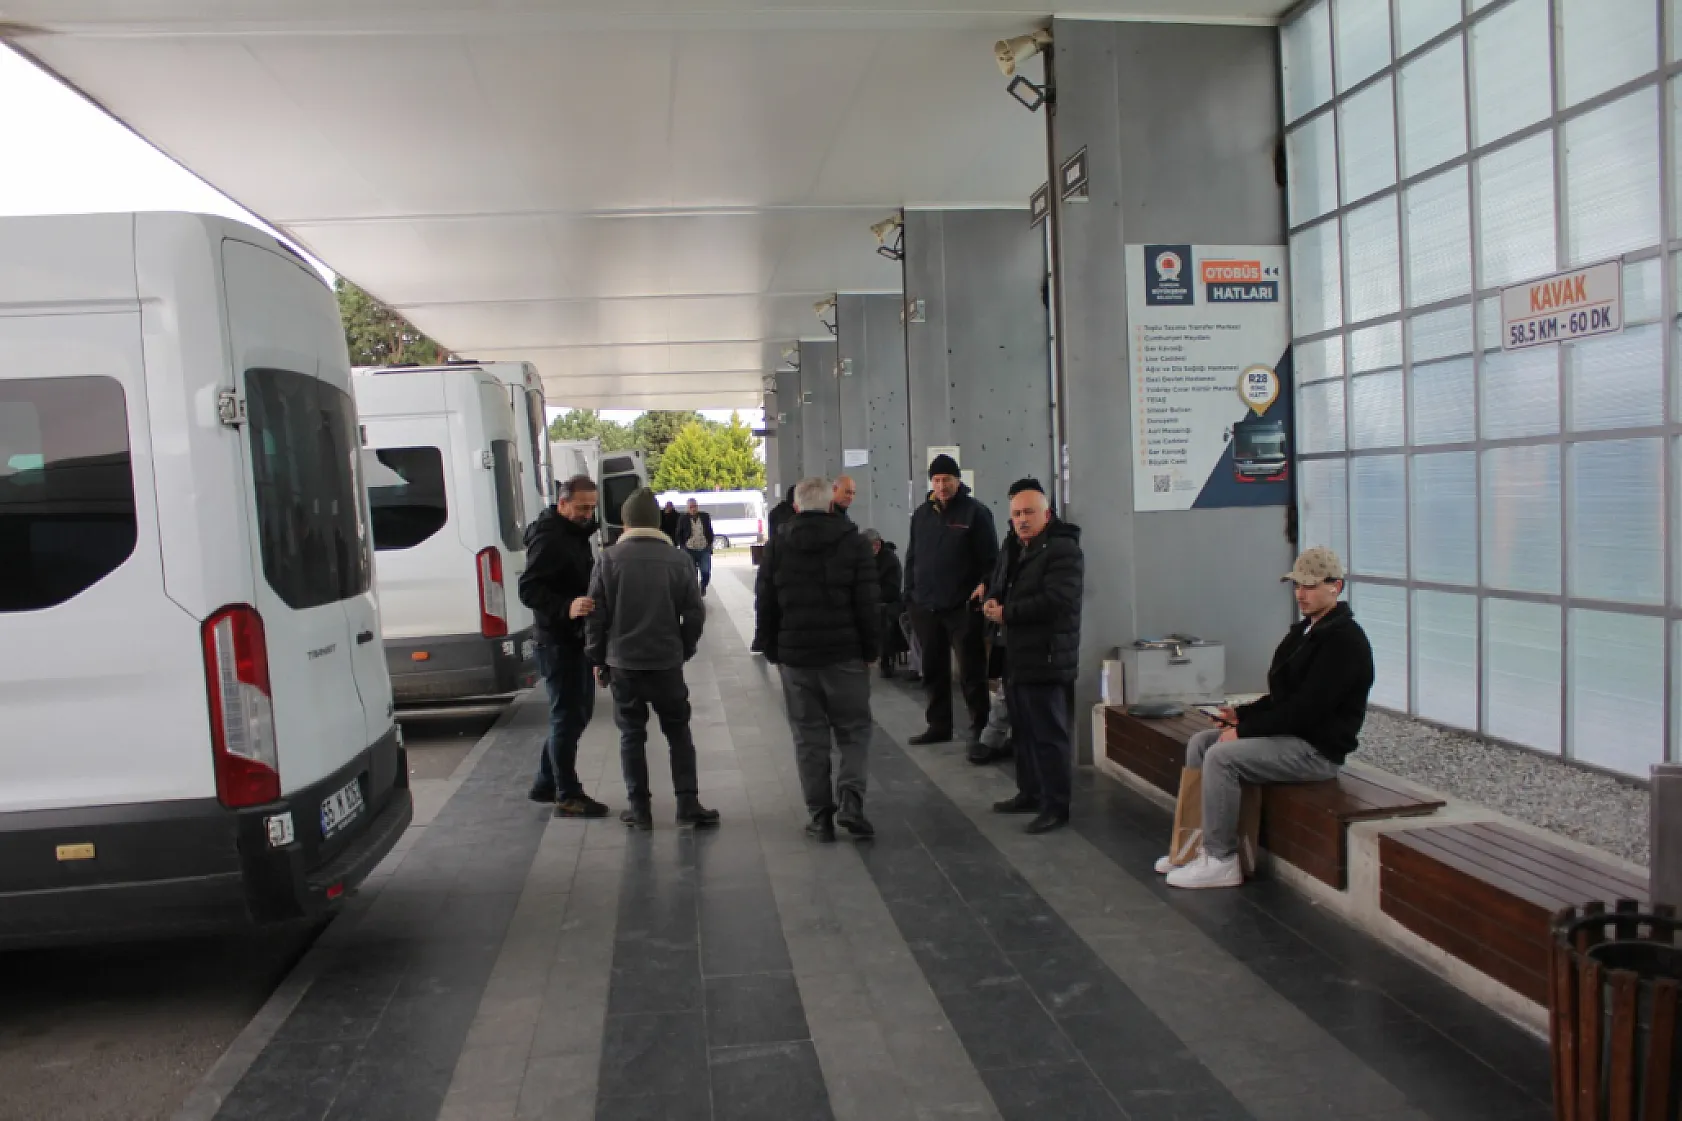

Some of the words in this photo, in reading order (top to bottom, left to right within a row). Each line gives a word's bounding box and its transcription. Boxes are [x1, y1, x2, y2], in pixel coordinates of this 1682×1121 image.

[1206, 265, 1258, 279] OTOBÜS
[1213, 286, 1273, 300] HATLARI
[1531, 275, 1586, 312] KAVAK
[1511, 322, 1535, 345] 58.5
[1539, 318, 1557, 340] KM
[1570, 312, 1587, 333] 60
[1592, 307, 1610, 330] DK
